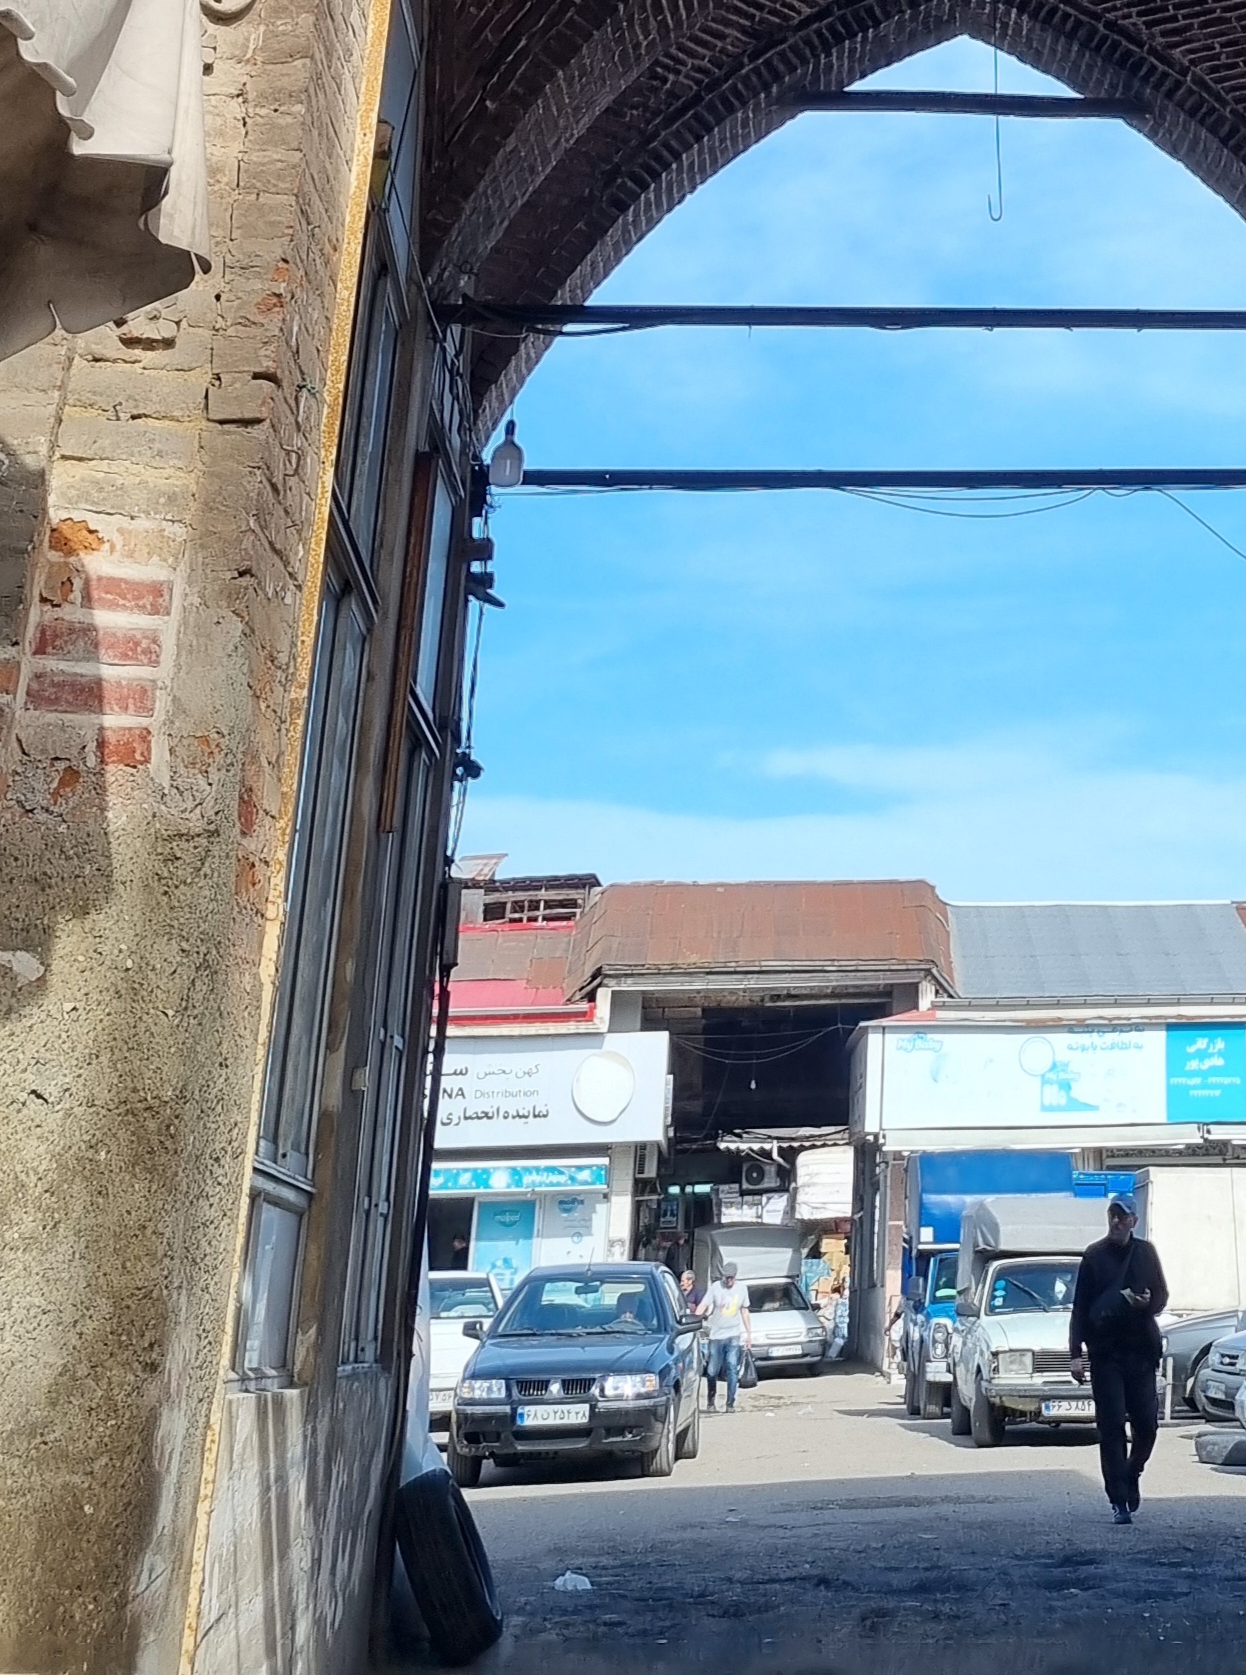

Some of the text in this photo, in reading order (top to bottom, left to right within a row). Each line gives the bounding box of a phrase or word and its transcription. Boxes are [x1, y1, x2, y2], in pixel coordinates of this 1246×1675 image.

[1099, 1039, 1131, 1050] لطافت
[476, 1064, 512, 1080] پخش
[515, 1063, 541, 1078] کهن
[474, 1088, 540, 1100] Distribution
[441, 1106, 500, 1126] انحصاری
[503, 1104, 550, 1124] نماینده
